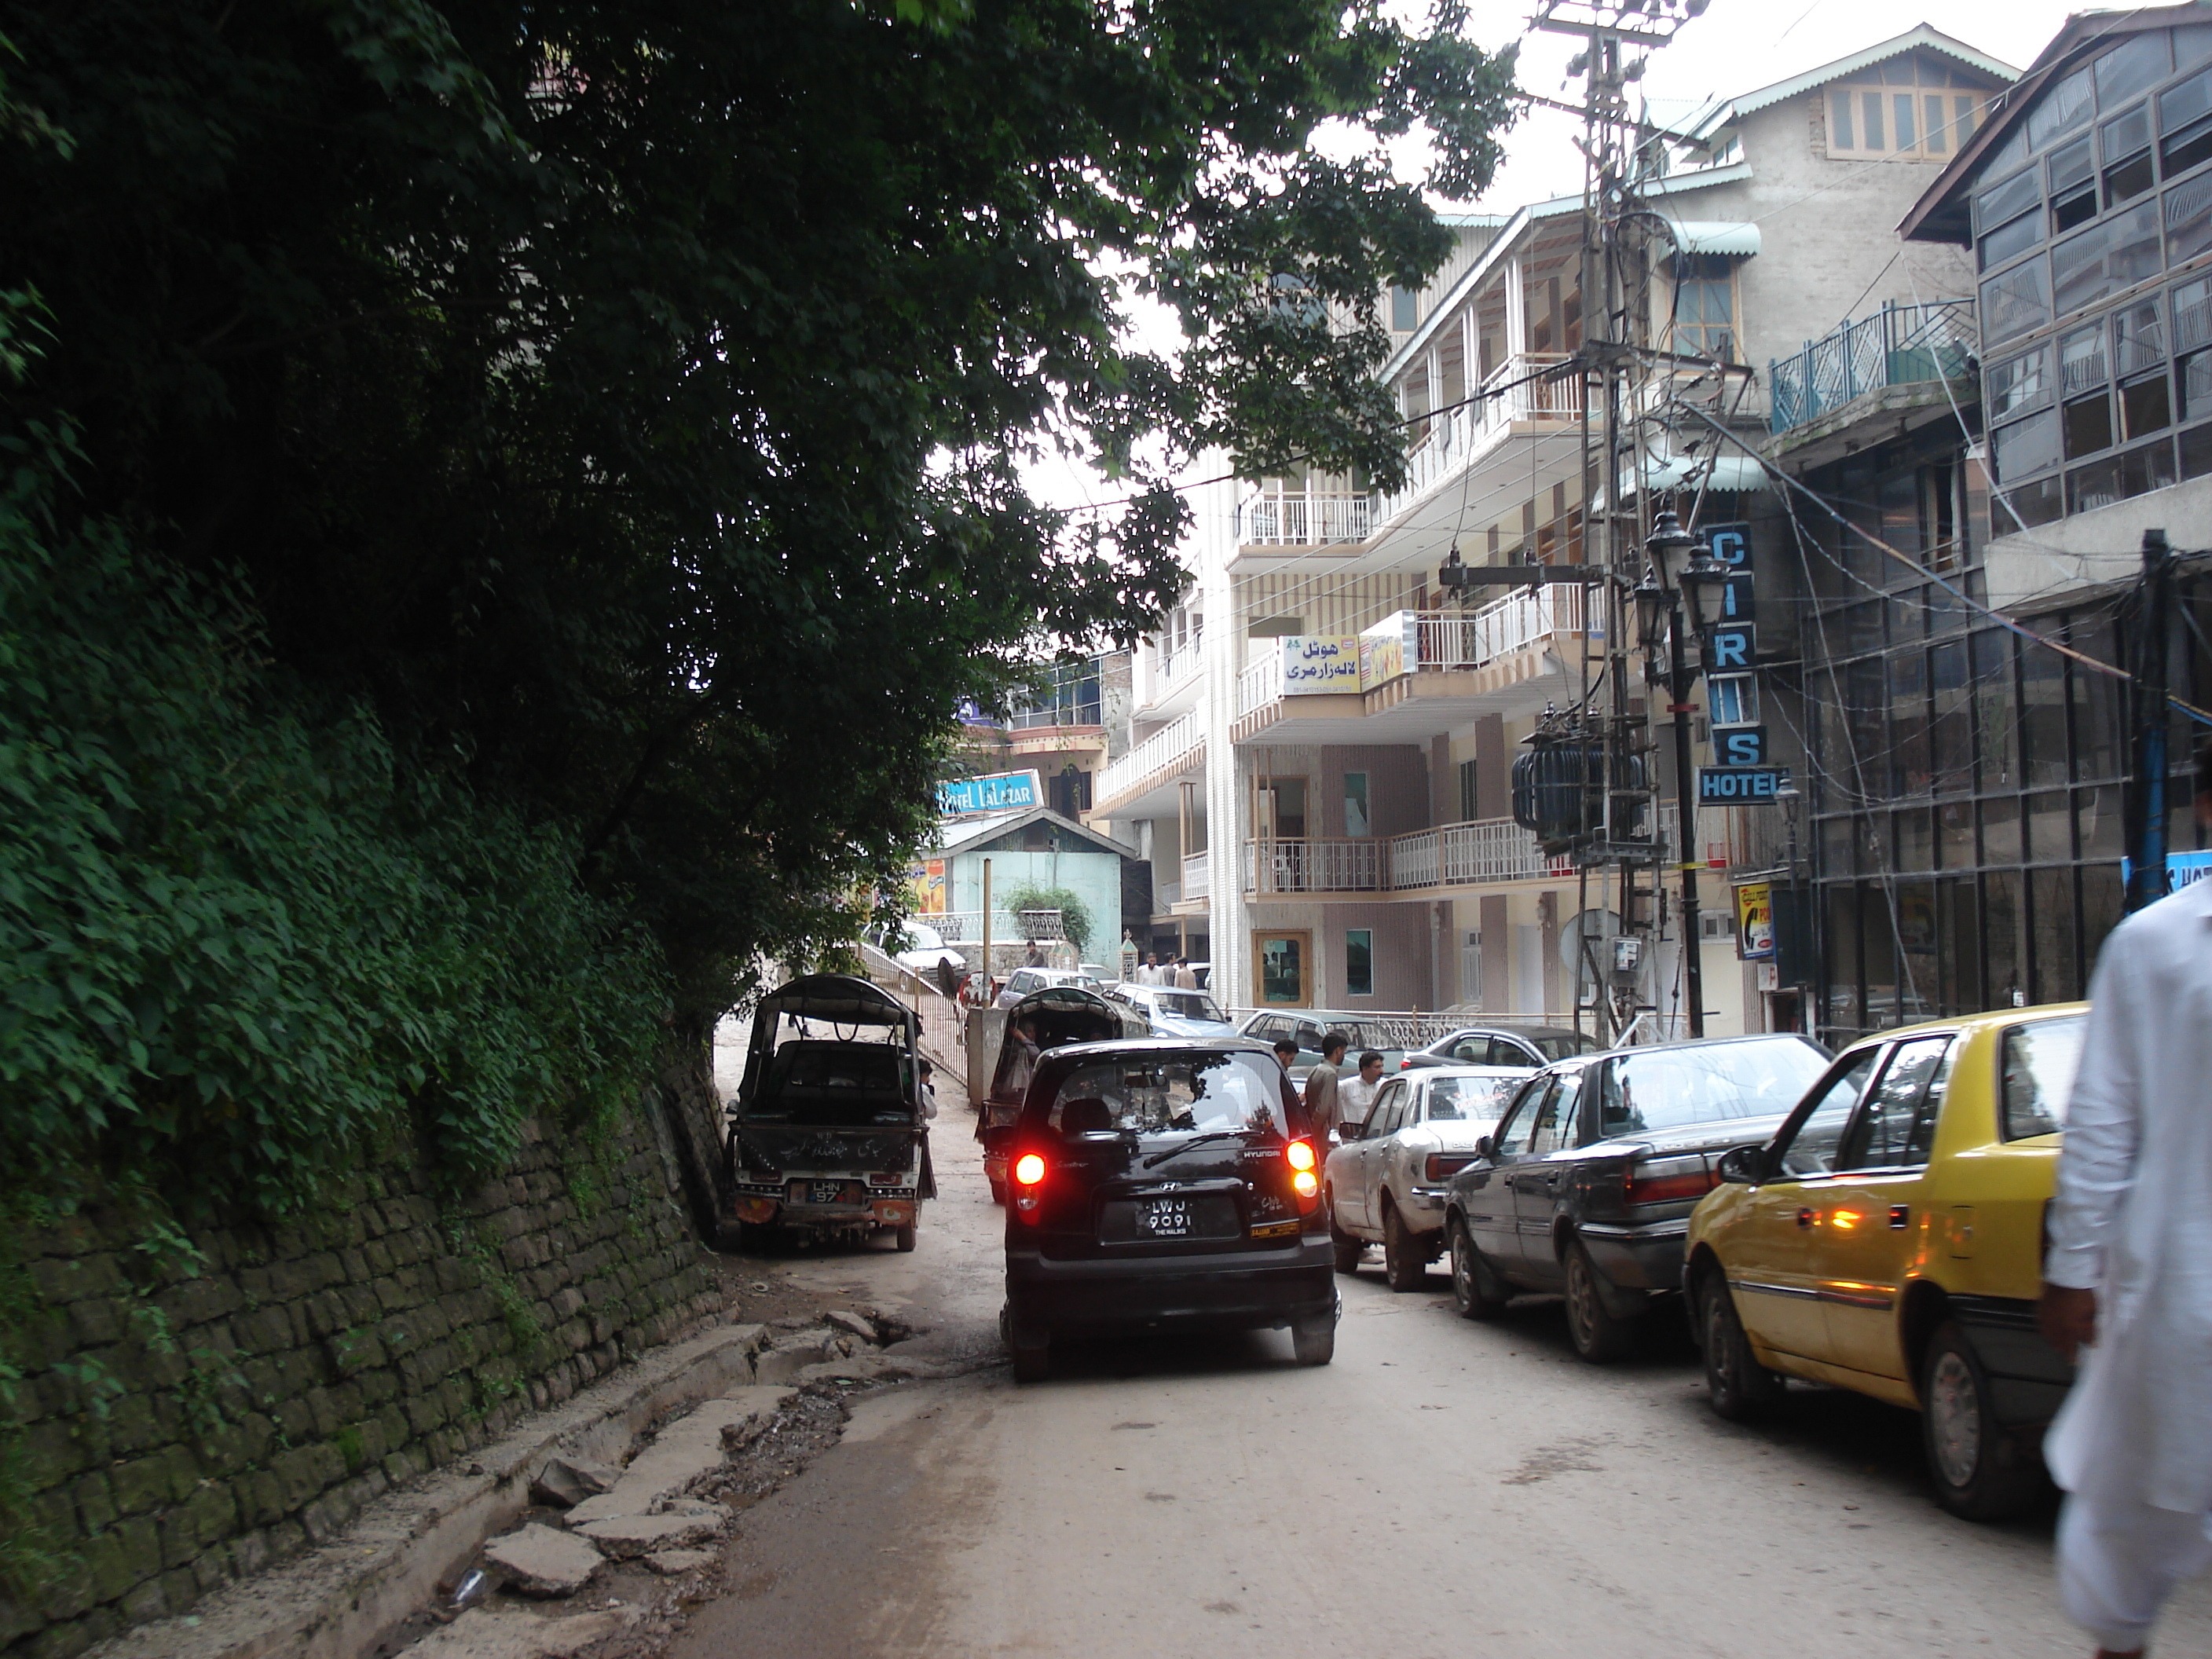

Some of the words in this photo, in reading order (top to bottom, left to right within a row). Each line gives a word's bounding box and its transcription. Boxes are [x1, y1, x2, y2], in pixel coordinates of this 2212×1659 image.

[1703, 773, 1780, 797] HOTEL
[813, 1181, 840, 1192] LHN
[816, 1192, 837, 1202] 97
[1152, 1200, 1185, 1214] LWJ
[1149, 1214, 1192, 1229] 9091
